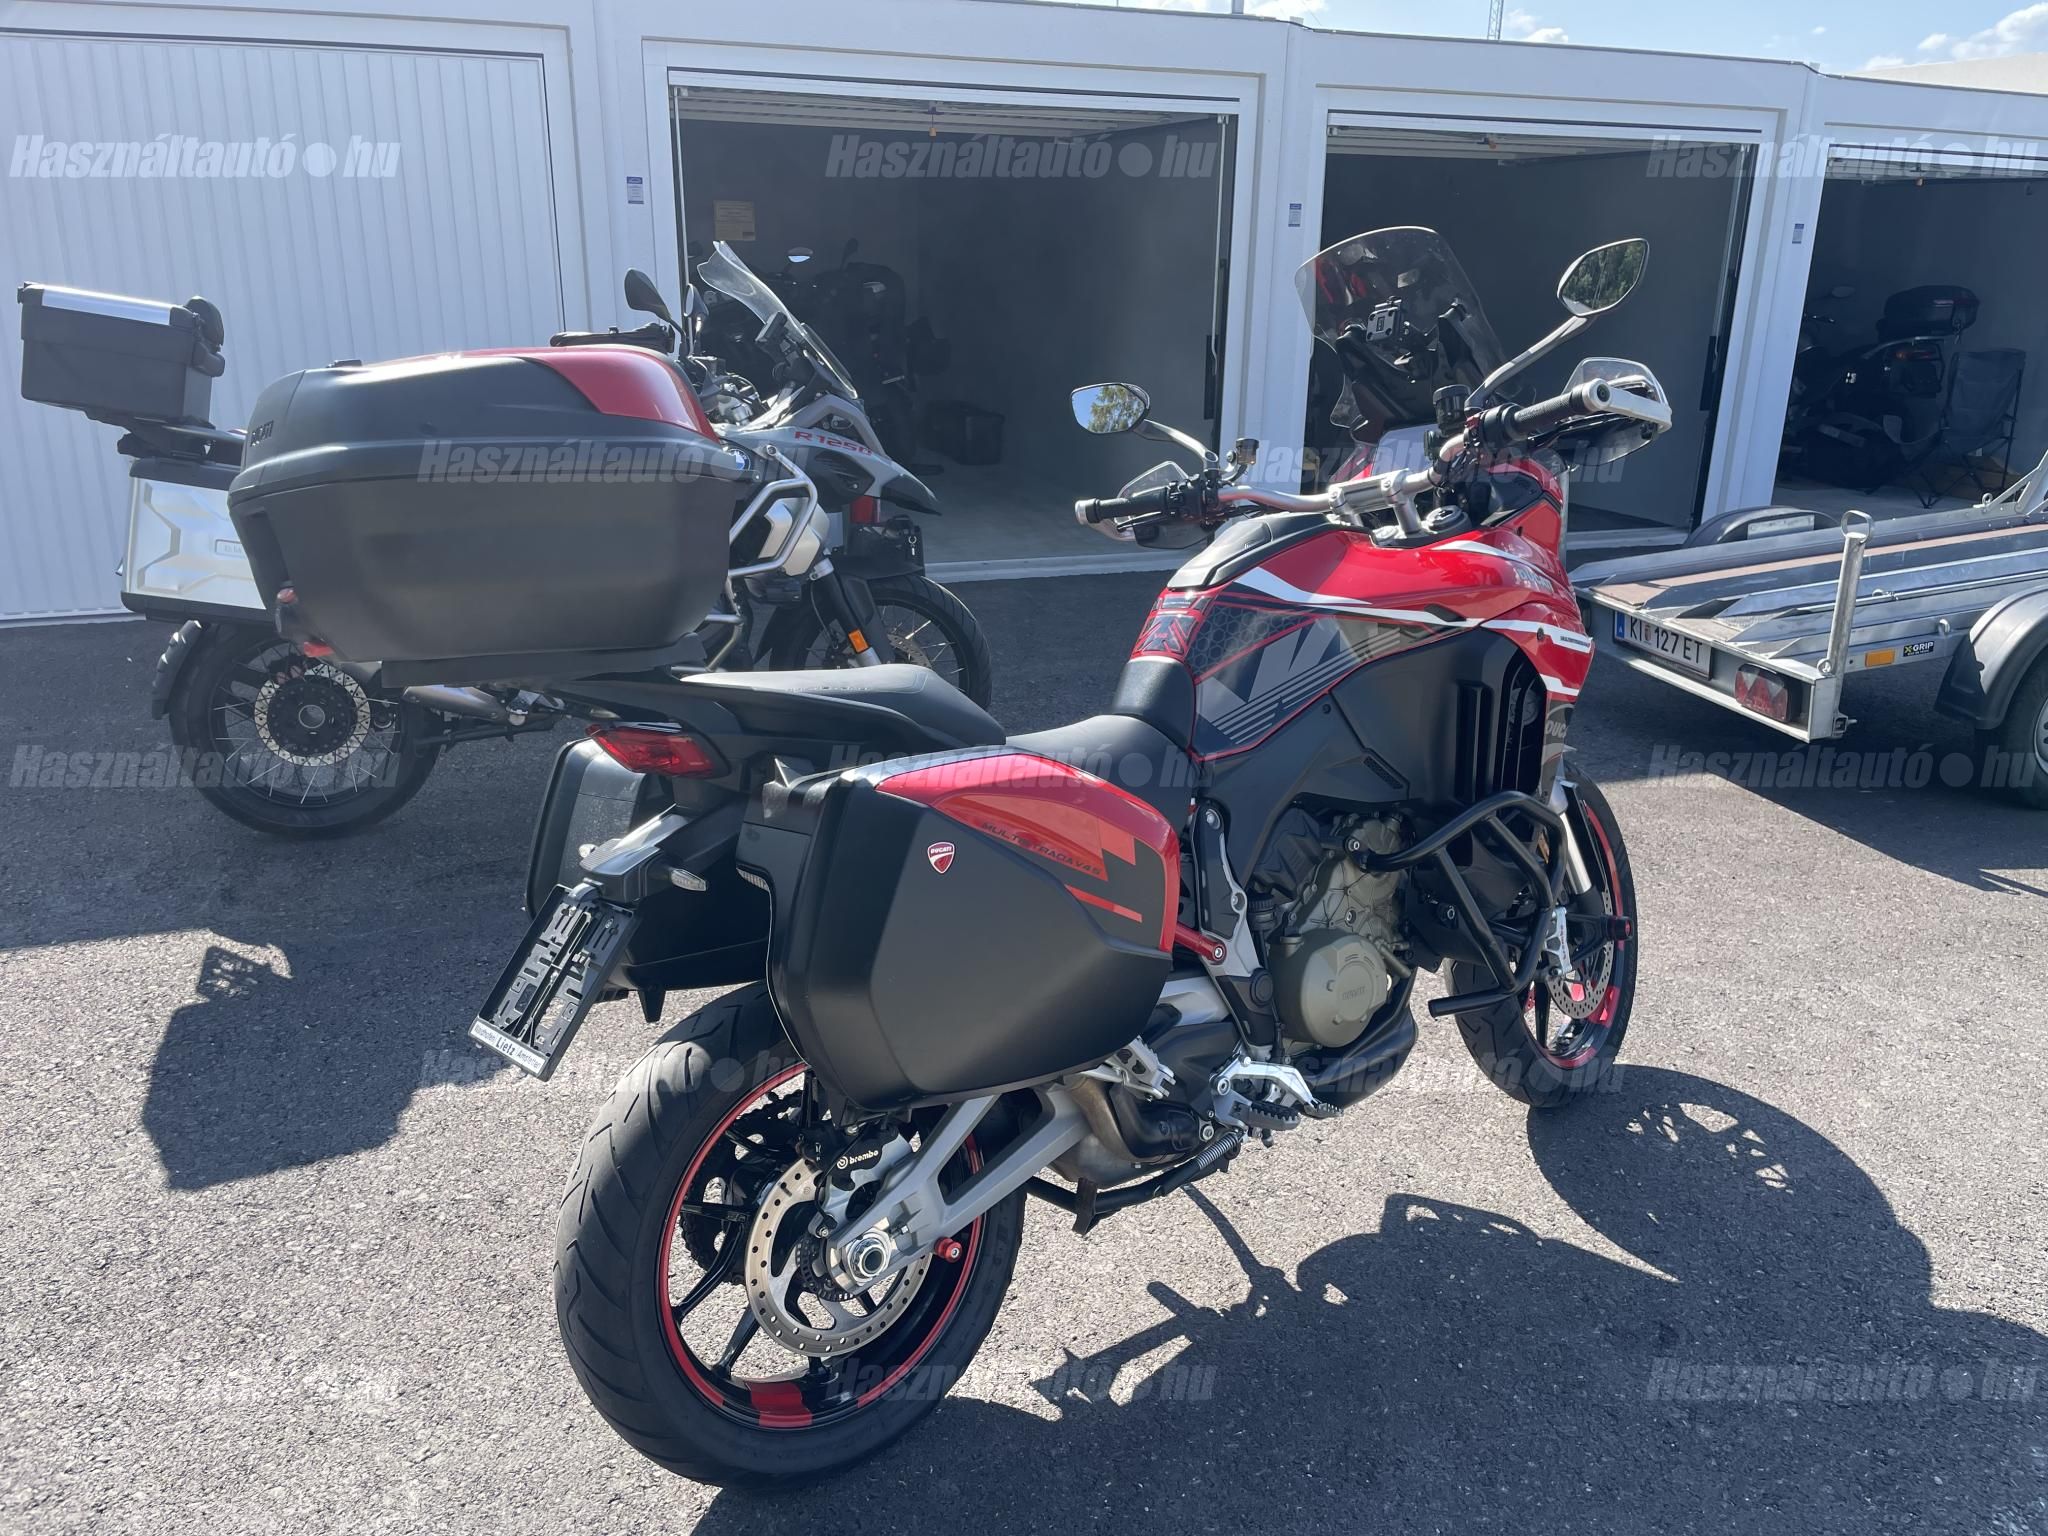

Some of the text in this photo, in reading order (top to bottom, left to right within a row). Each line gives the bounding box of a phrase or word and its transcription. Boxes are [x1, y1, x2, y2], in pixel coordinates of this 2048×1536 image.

[795, 431, 813, 442] R
[1654, 626, 1680, 654] 127
[1683, 637, 1703, 664] ET
[930, 846, 952, 854] DUCATI
[496, 1035, 517, 1056] Lietz
[850, 1149, 879, 1164] brembo
